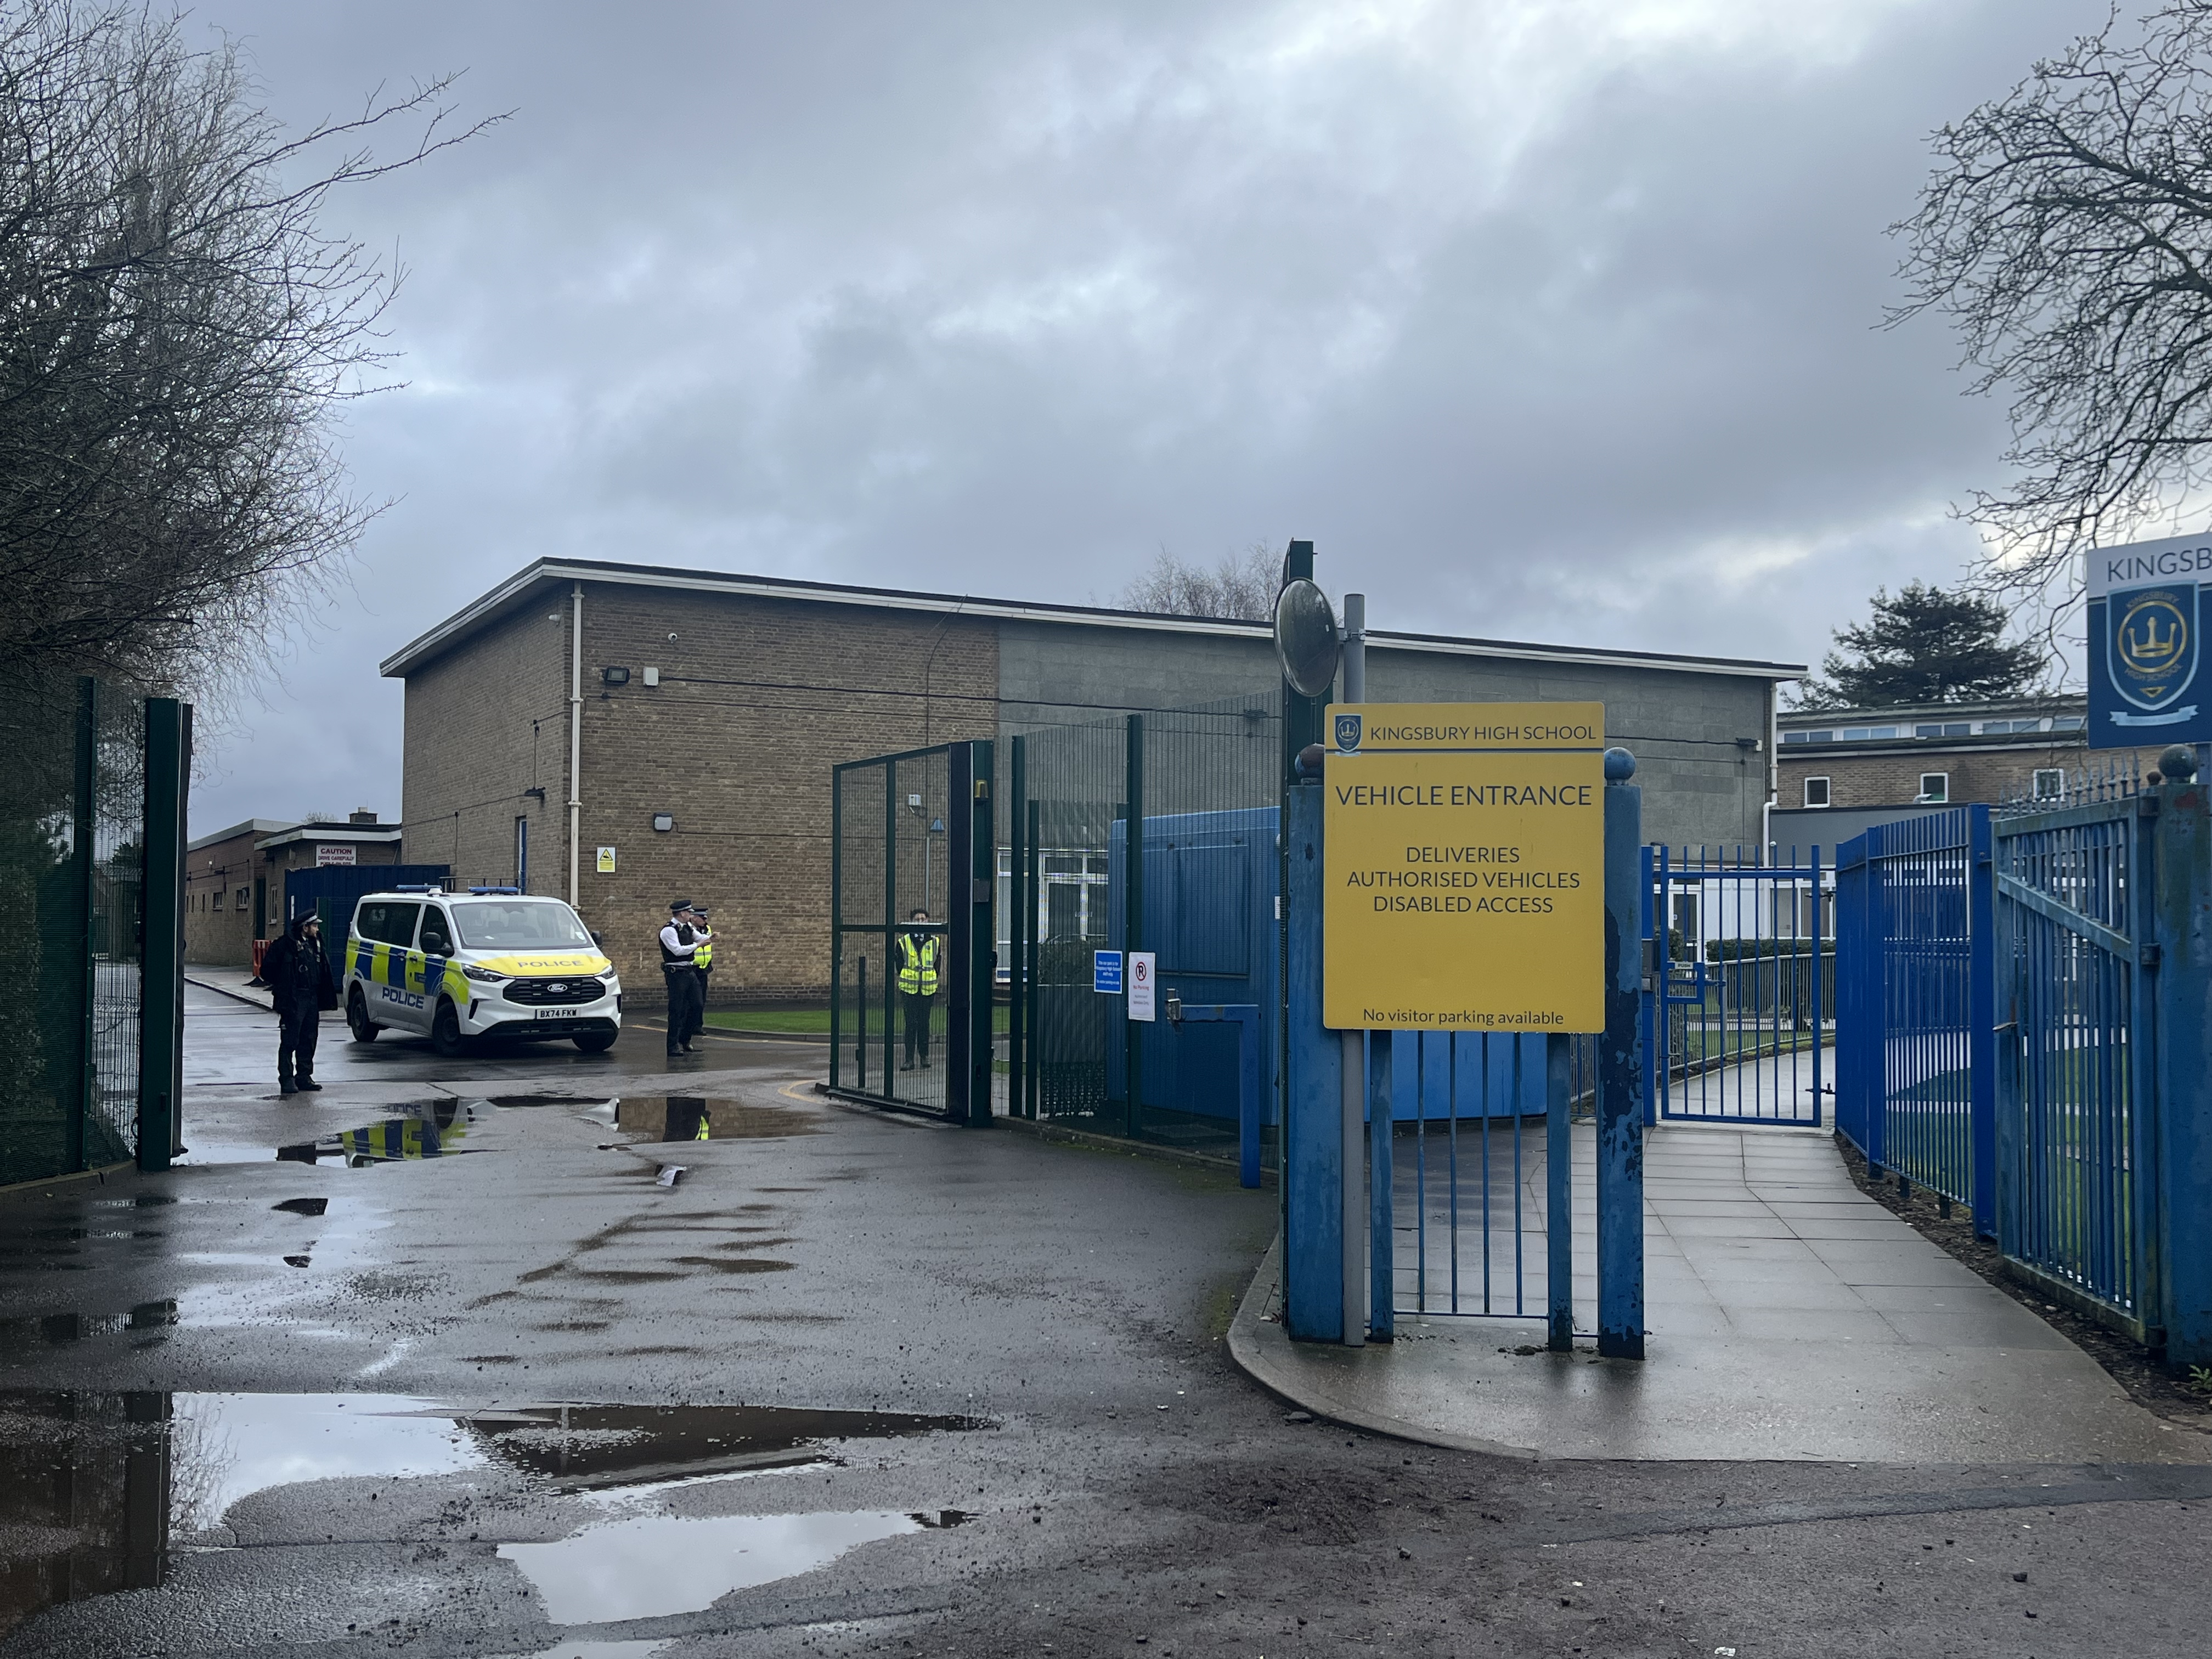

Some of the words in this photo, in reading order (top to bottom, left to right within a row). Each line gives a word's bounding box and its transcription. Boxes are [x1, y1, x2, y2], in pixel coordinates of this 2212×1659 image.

[2108, 548, 2212, 582] KINGSB
[1371, 726, 1470, 741] KINGSBURY
[1475, 726, 1519, 740] HIGH
[1523, 726, 1596, 740] SCHOOL
[1336, 786, 1443, 805] VEHICLE
[1452, 786, 1592, 806] ENTRANCE
[1407, 847, 1520, 863] DELIVERIES
[1347, 871, 1478, 888] AUTHORISED
[1482, 872, 1580, 889] VEHICLES
[1374, 896, 1471, 912] DISABLED
[1476, 896, 1553, 913] ACCESS
[382, 986, 425, 1009] POLICE
[1364, 1008, 1384, 1022] No
[1388, 1009, 1435, 1022] visitor
[1438, 1009, 1494, 1026] parking
[1498, 1011, 1564, 1025] available
